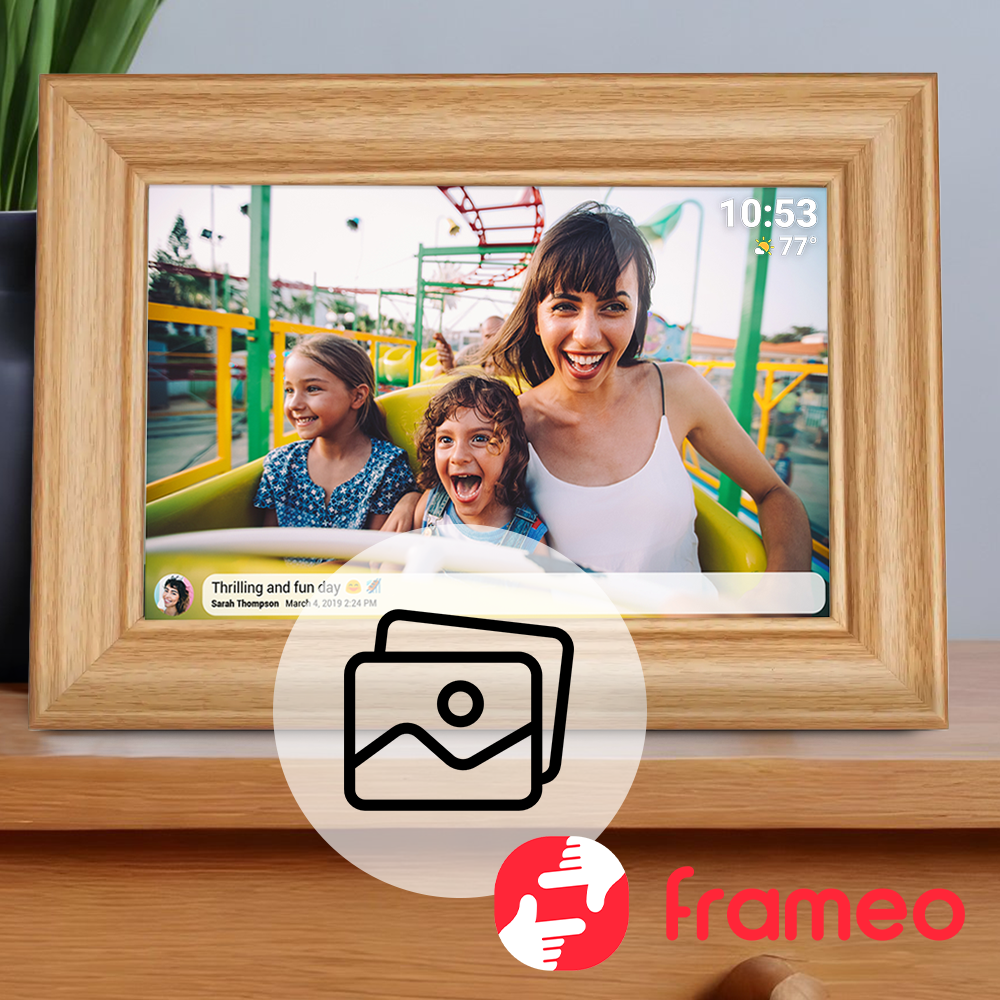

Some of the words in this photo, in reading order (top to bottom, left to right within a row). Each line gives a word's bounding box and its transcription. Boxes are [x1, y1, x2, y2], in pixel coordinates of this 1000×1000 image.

[720, 198, 817, 228] 10:53
[211, 580, 264, 597] Thrilling
[266, 580, 291, 594] and
[294, 580, 315, 594] fun
[318, 580, 342, 597] day
[211, 599, 235, 609] Sarah
[237, 599, 280, 611] Thompson
[285, 599, 312, 608] March
[313, 599, 321, 609] 4,
[322, 599, 343, 608] 2019
[344, 599, 362, 608] 2:24
[363, 599, 378, 608] PM
